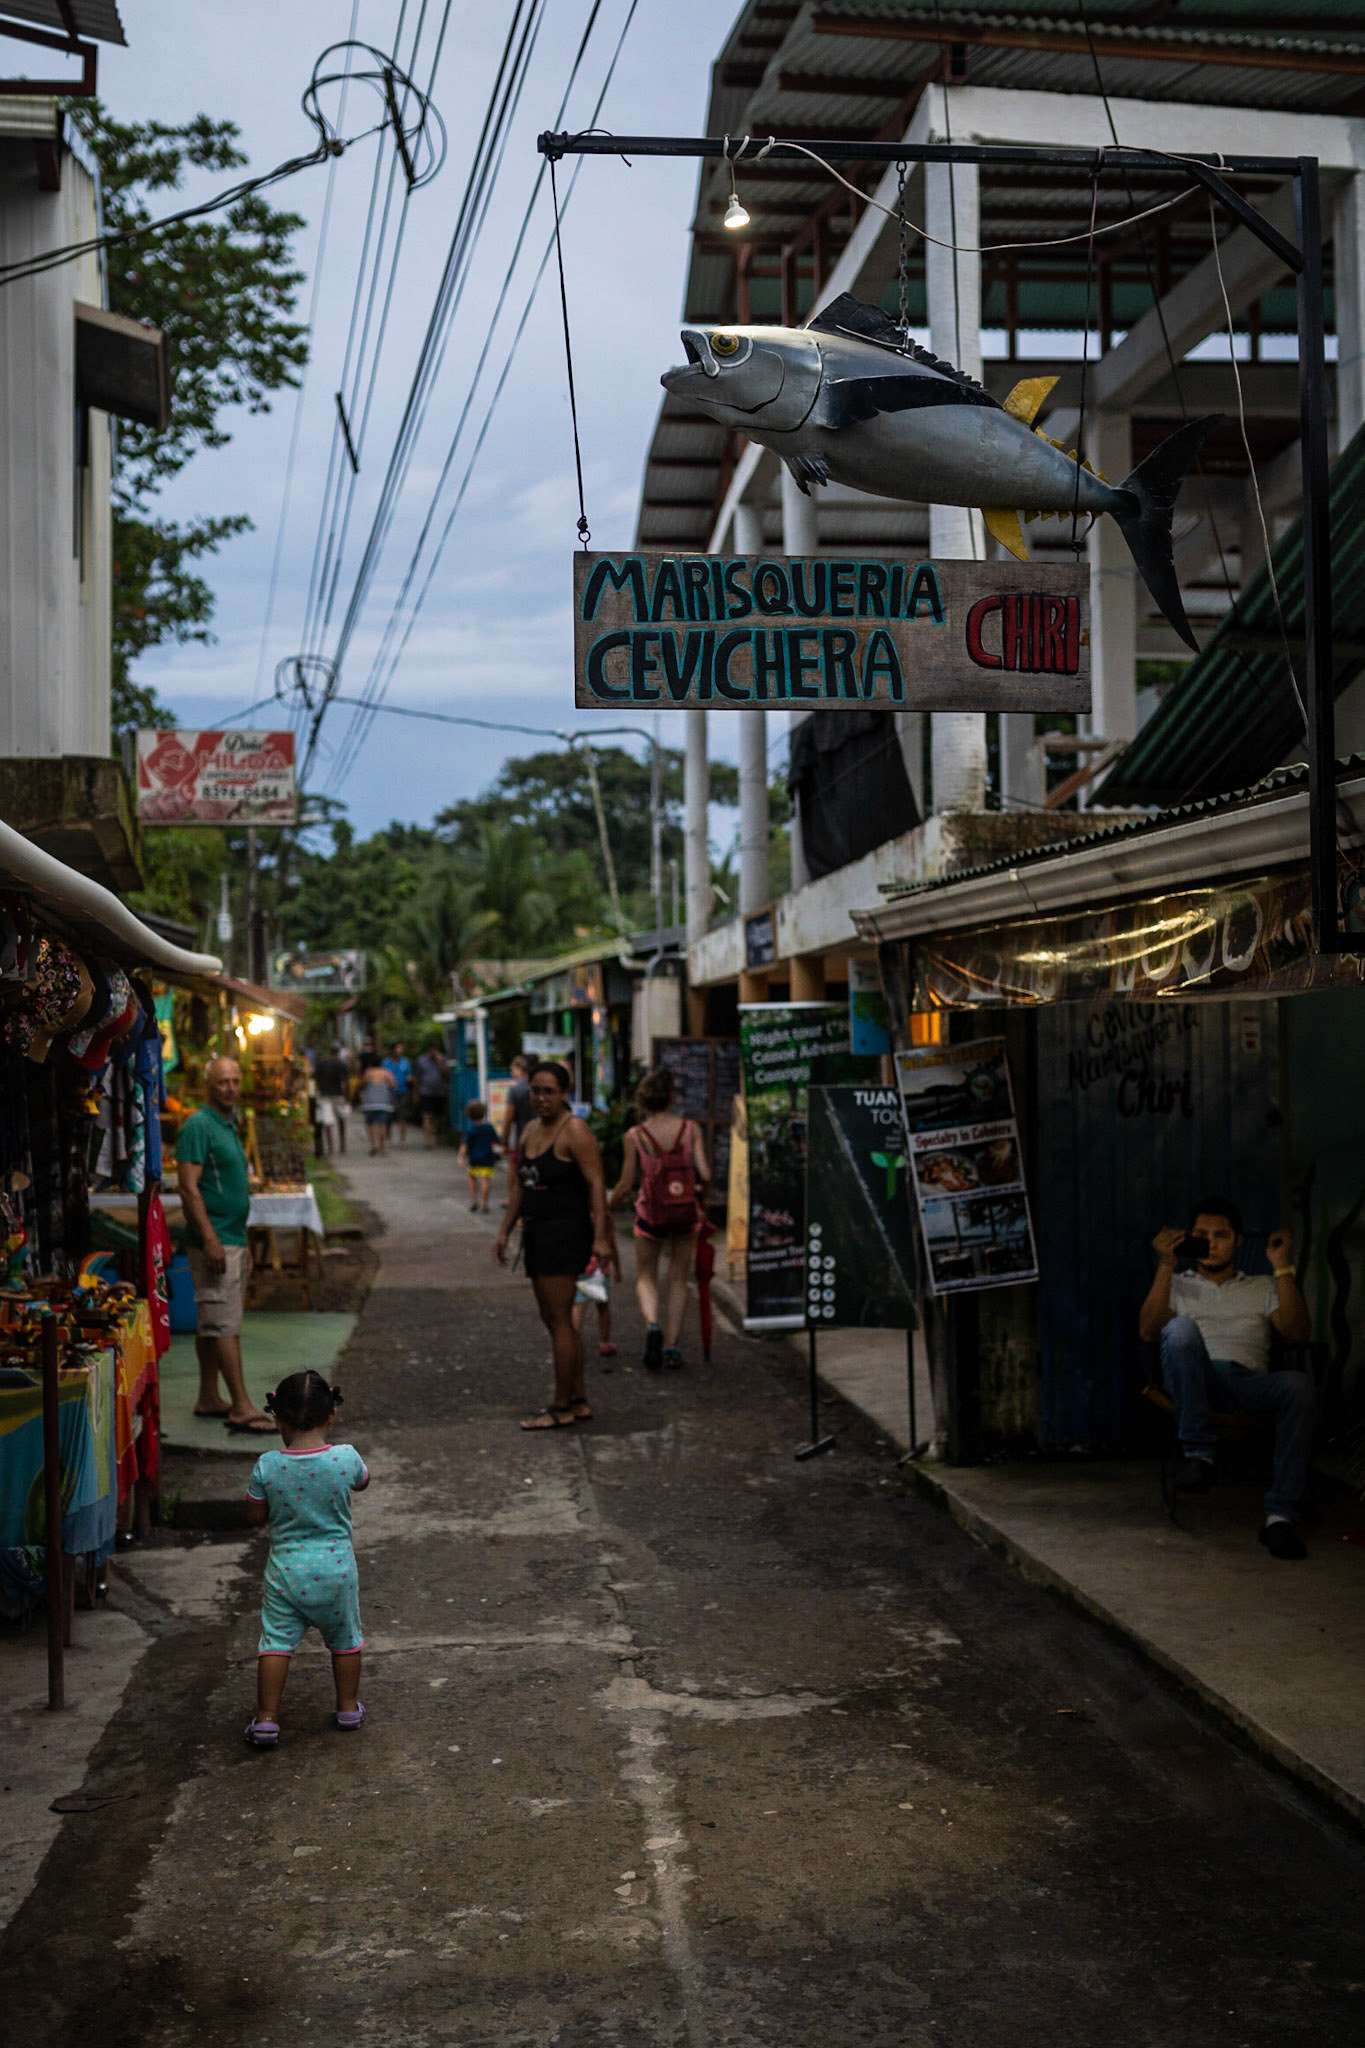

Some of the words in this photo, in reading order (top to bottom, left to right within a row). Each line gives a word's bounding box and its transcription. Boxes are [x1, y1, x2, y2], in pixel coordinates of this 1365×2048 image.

[581, 557, 945, 625] MARISQUERIA
[586, 627, 905, 702] CEVICHERA
[966, 594, 1080, 674] CHIRI
